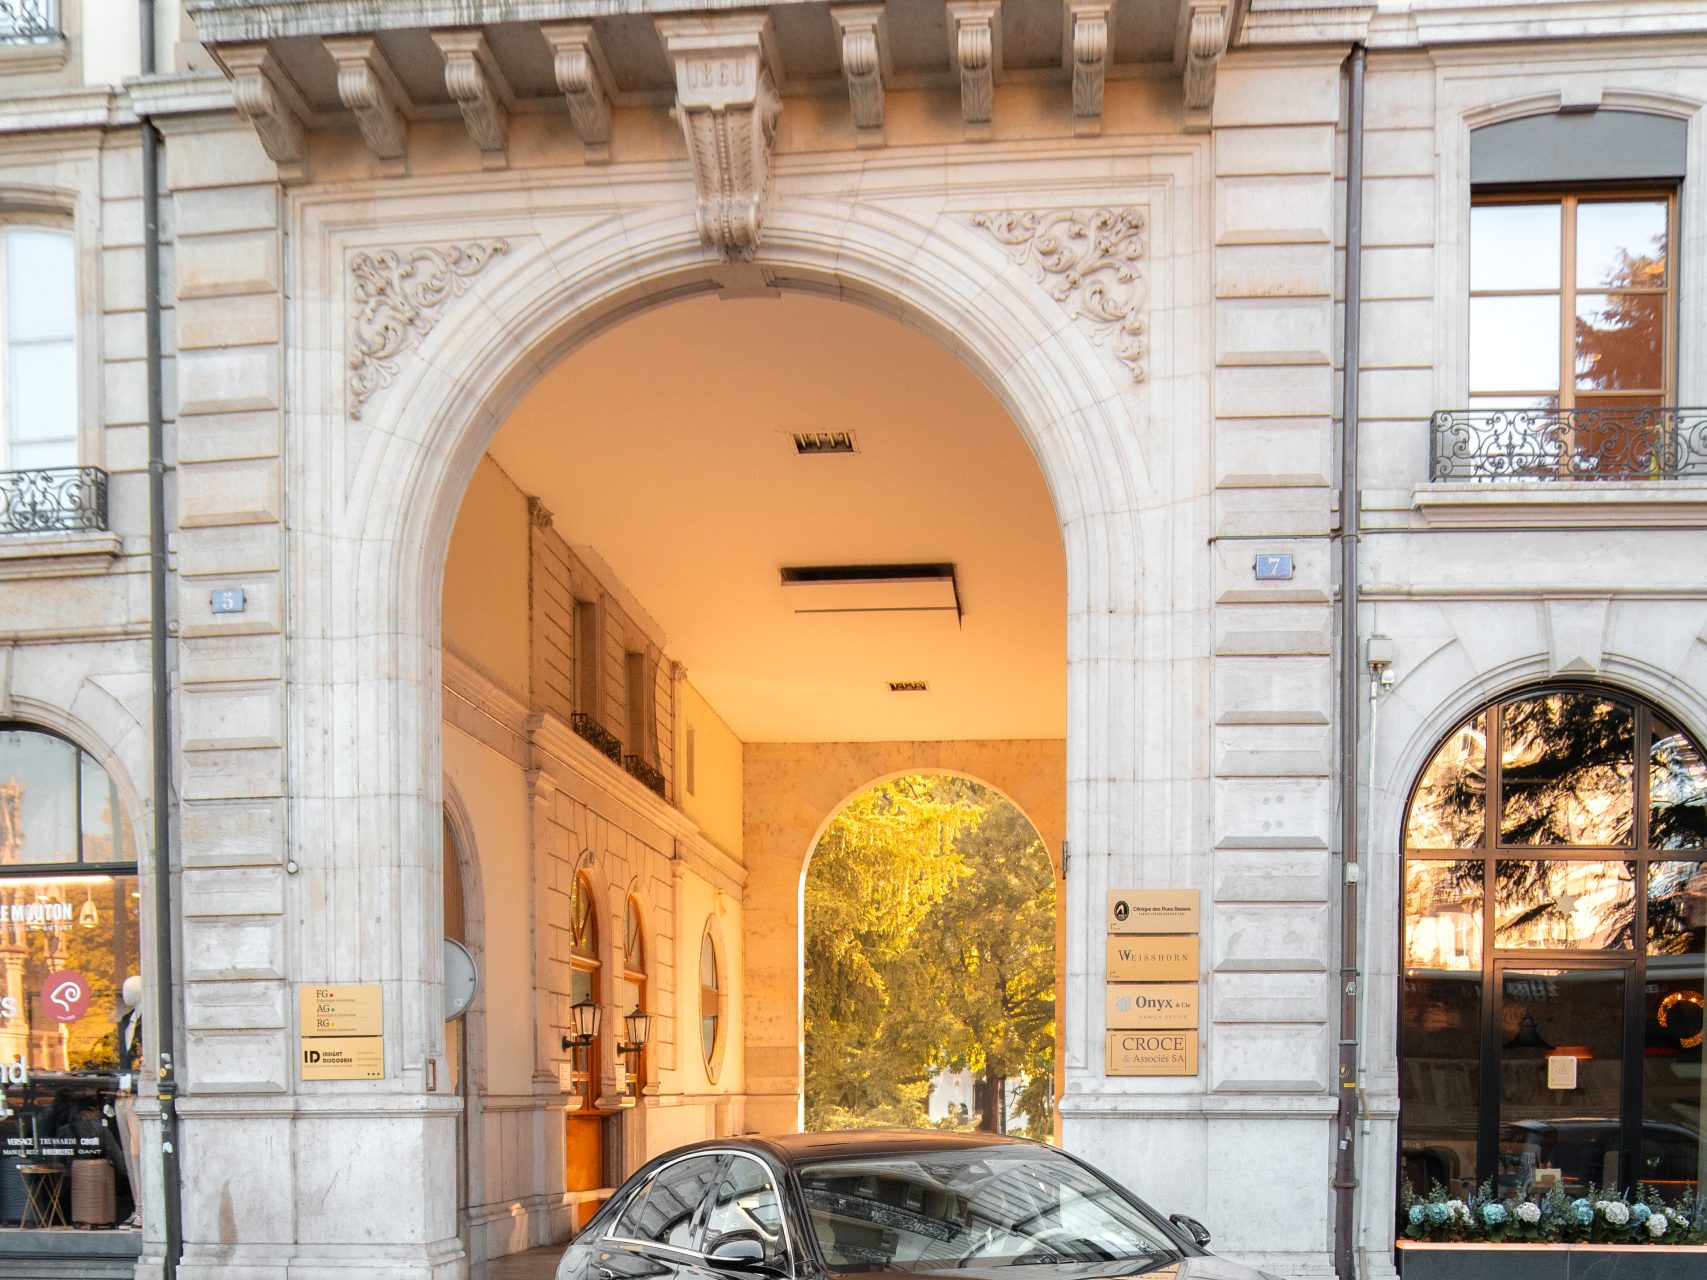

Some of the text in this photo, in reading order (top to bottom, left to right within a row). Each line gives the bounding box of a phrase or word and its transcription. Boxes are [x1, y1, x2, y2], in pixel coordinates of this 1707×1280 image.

[1268, 557, 1281, 577] 7
[222, 591, 234, 610] 5
[11, 903, 73, 922] MOUTON
[316, 989, 329, 998] FG
[316, 1004, 330, 1013] AG
[1135, 995, 1173, 1012] Onyx
[316, 1018, 330, 1028] RG
[1122, 1037, 1184, 1051] CROCE
[304, 1050, 321, 1064] ID
[1132, 1054, 1169, 1063] Associés
[1171, 1054, 1185, 1063] SA
